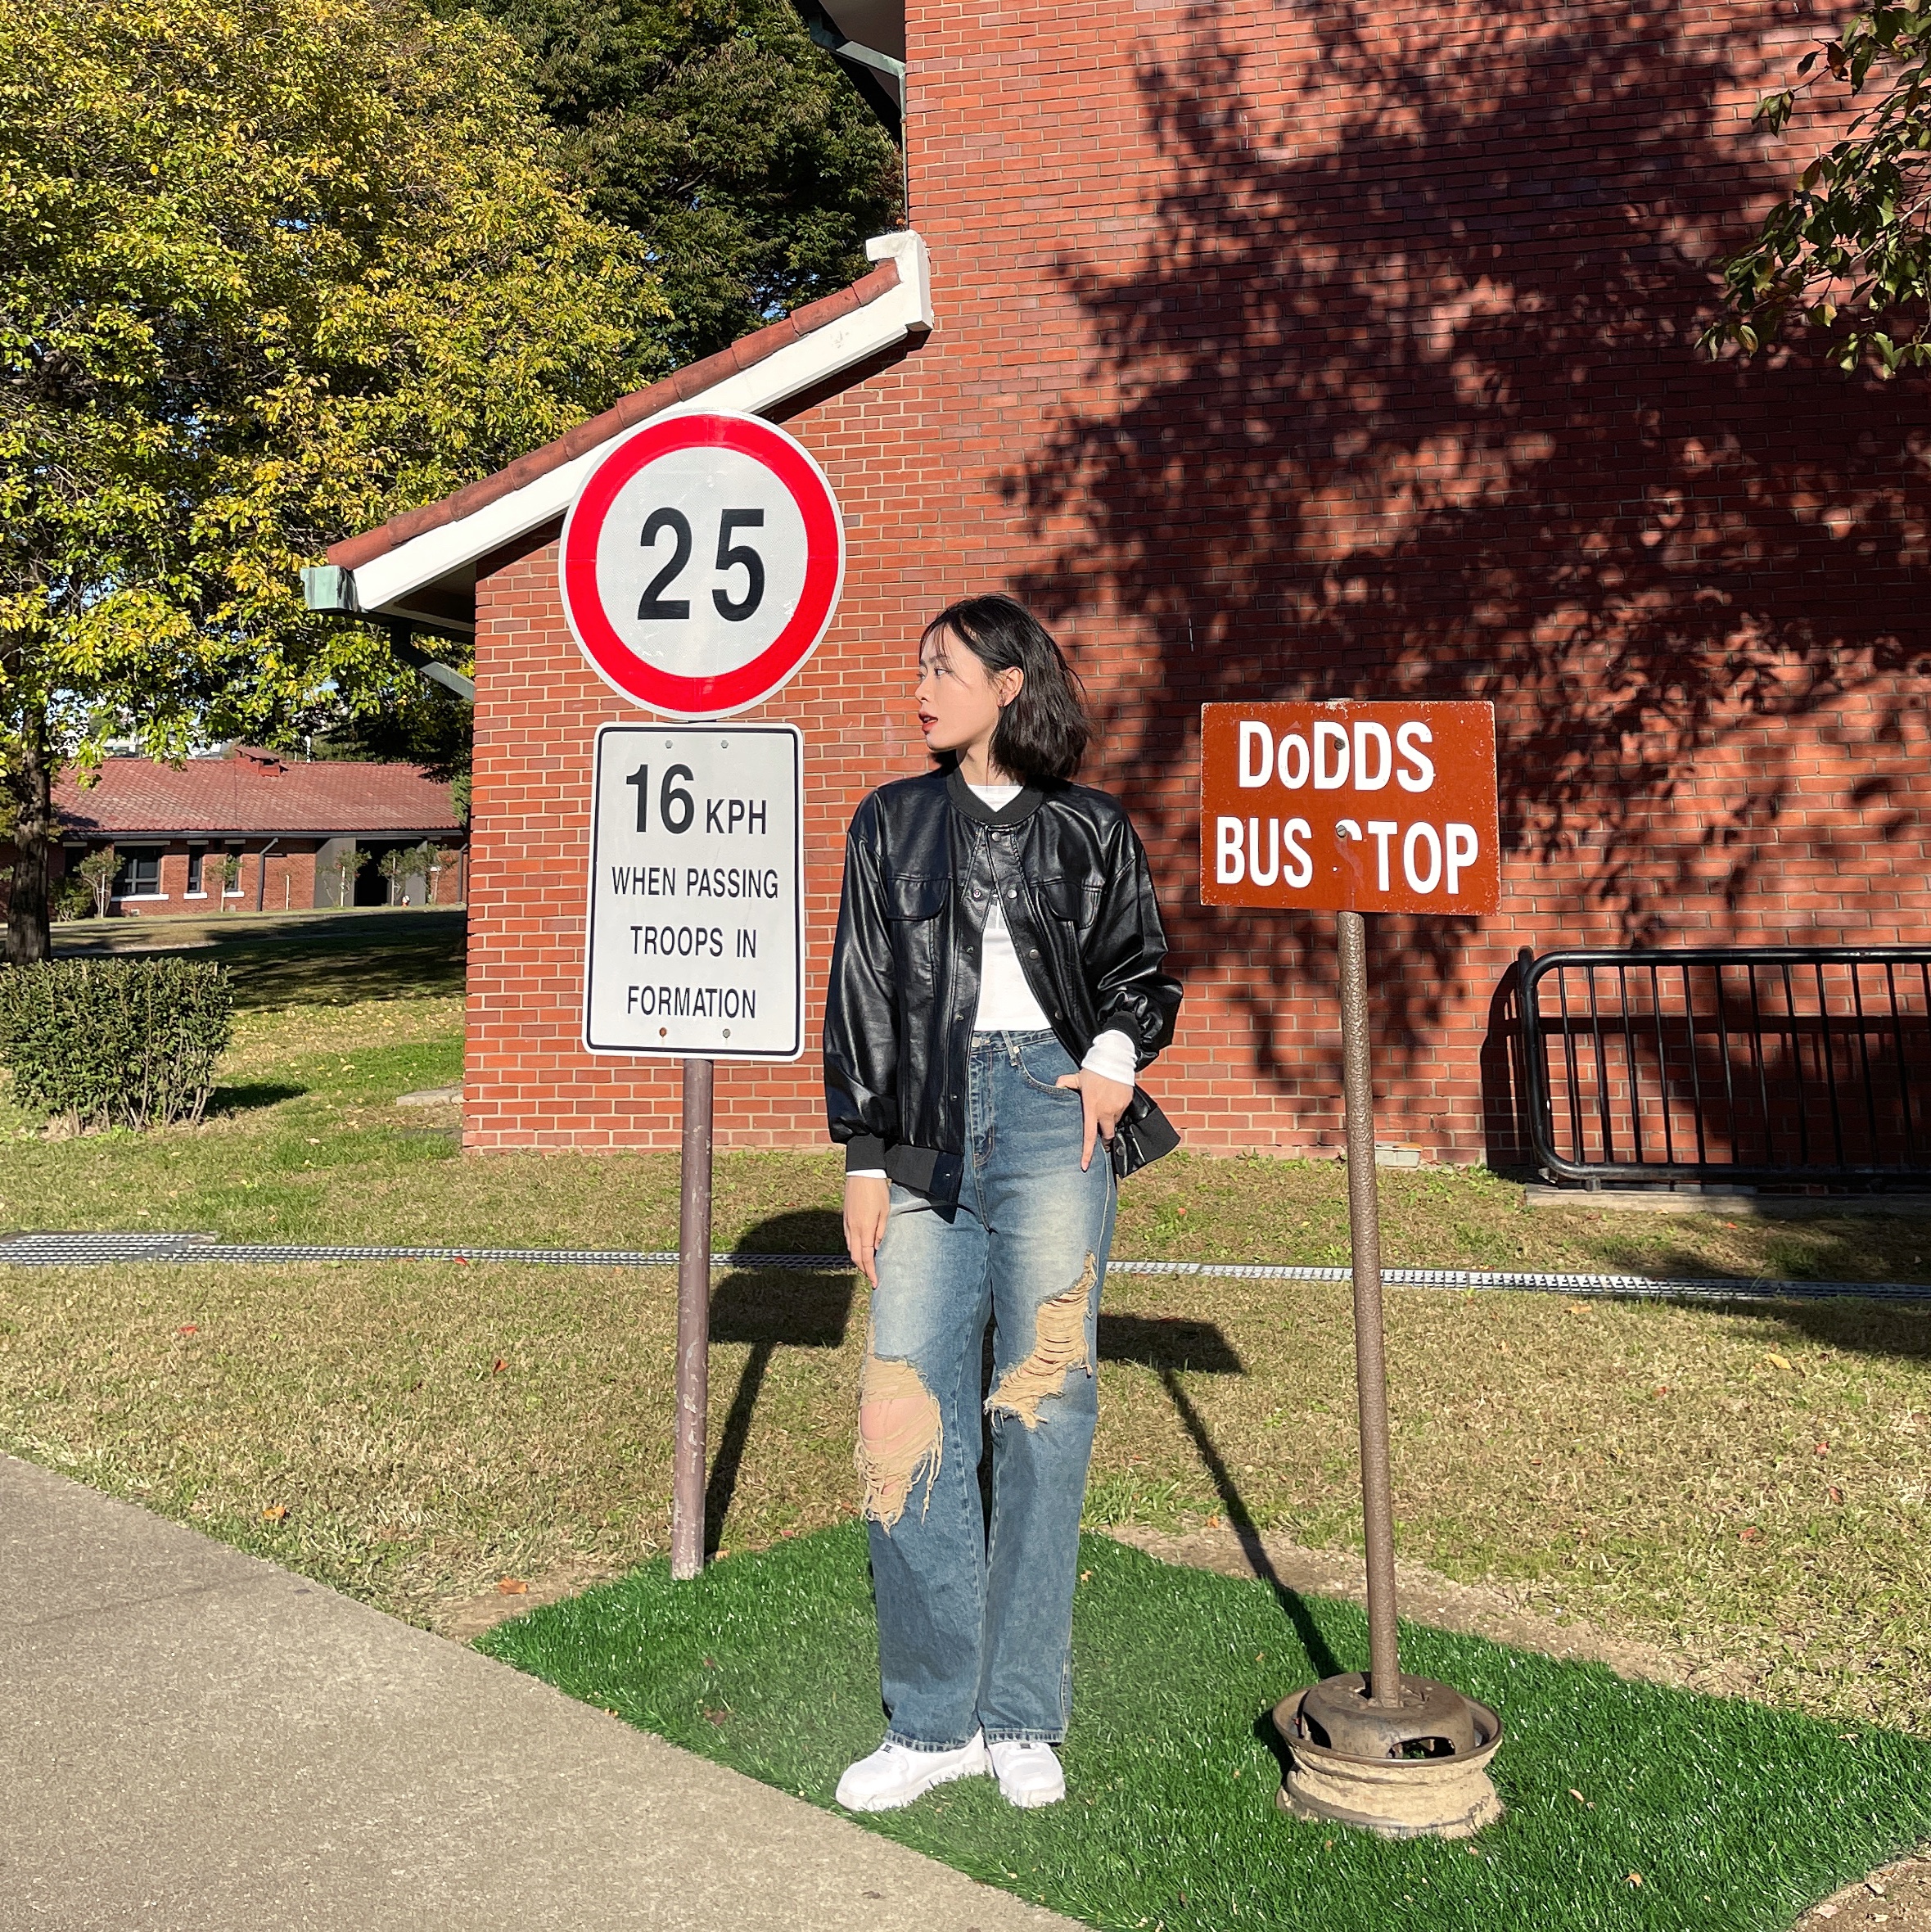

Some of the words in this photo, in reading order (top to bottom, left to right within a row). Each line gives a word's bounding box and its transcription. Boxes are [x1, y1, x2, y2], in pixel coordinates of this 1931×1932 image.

[637, 507, 765, 622] 25
[1238, 720, 1437, 793] DoDDS
[625, 763, 695, 834] 16
[706, 798, 766, 835] KPH
[611, 866, 675, 896] WHEN
[687, 868, 778, 899] PASSING
[1216, 816, 1313, 888] BUS
[630, 925, 723, 957] TROOPS
[737, 928, 756, 959] IN
[627, 985, 756, 1018] FORMATION
